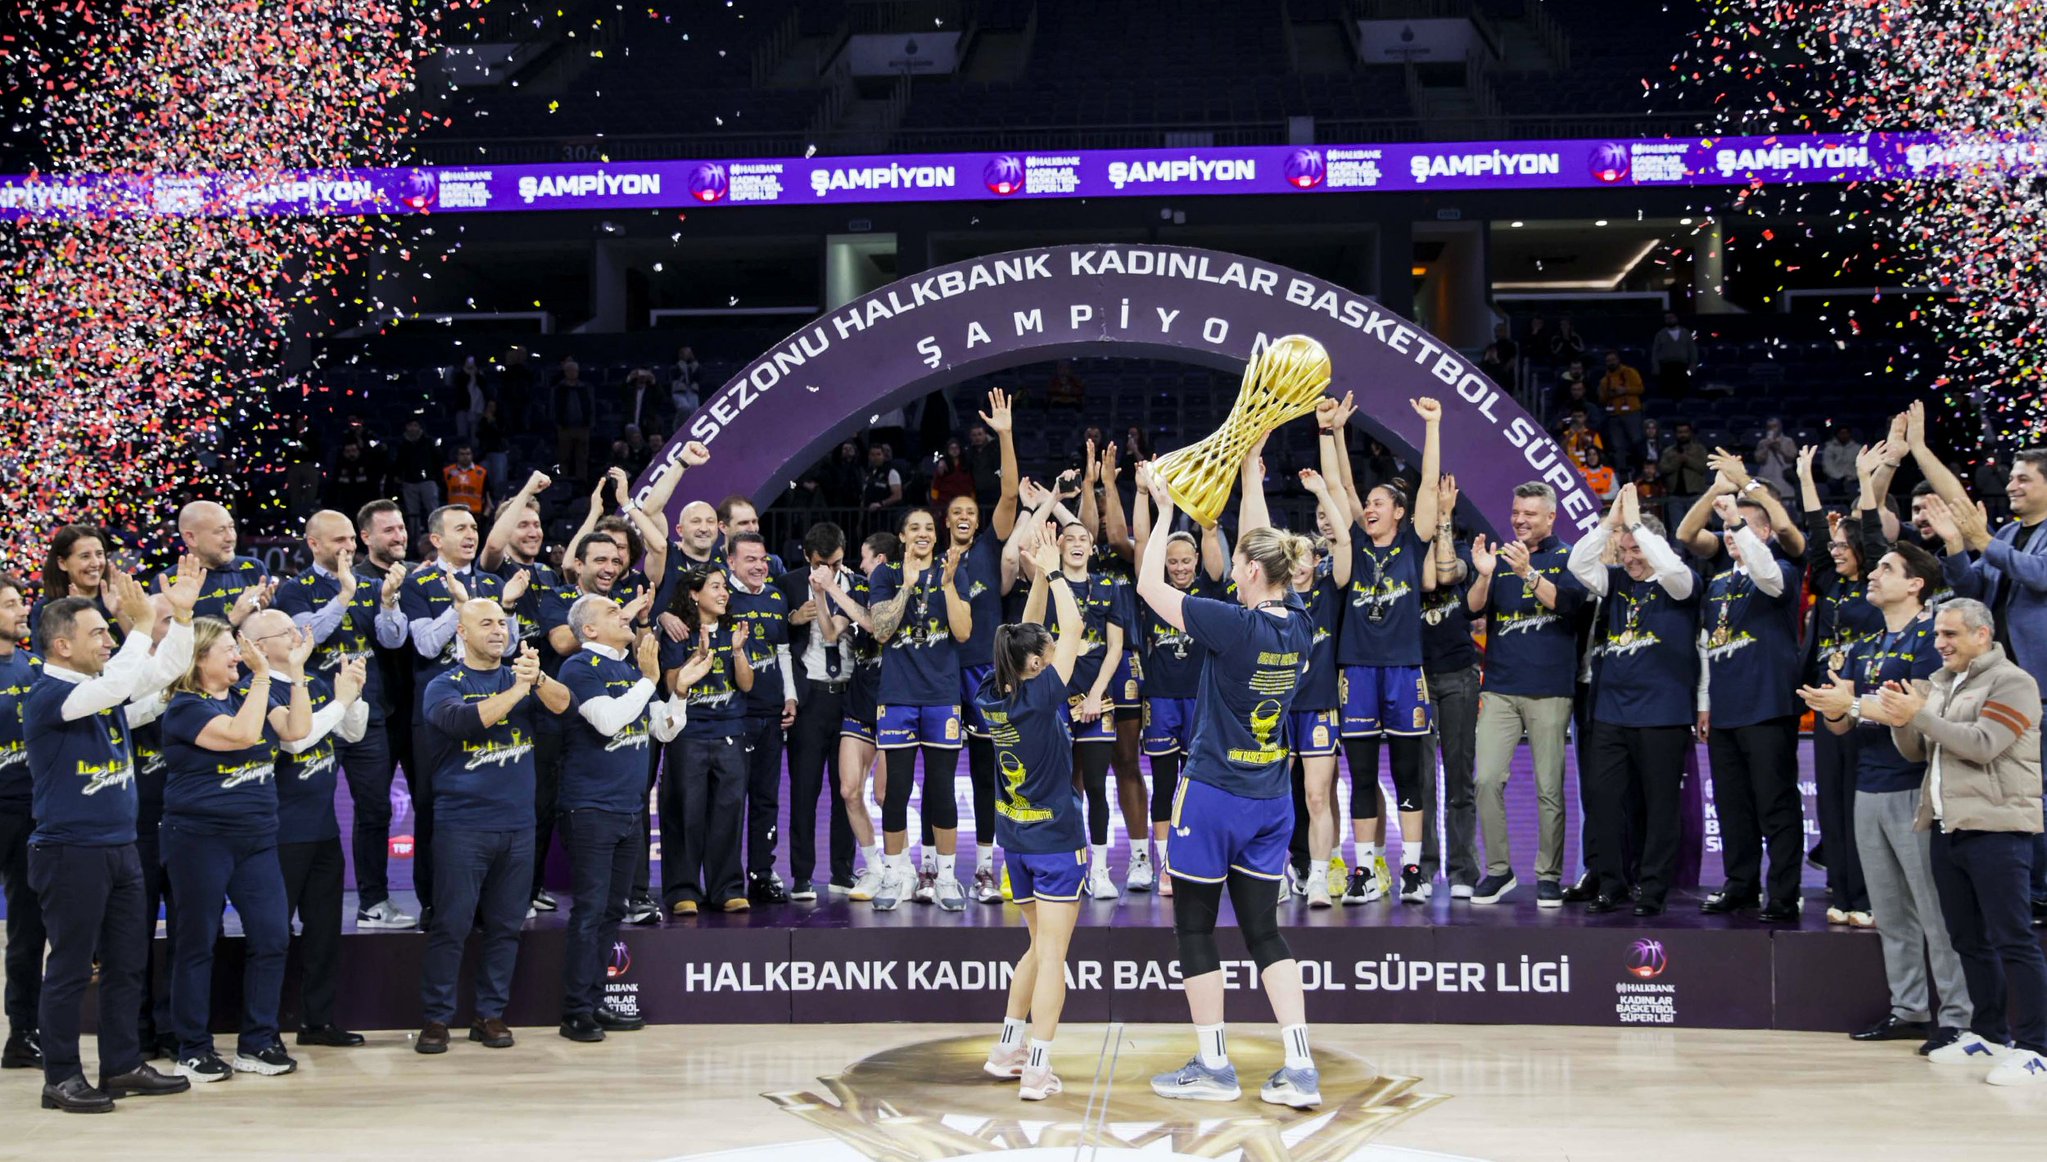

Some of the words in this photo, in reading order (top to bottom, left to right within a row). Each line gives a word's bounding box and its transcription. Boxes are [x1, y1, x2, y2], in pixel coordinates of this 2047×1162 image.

[1109, 155, 1256, 189] ŞAMPİYON
[1411, 149, 1559, 183] ŞAMPİYON
[1716, 142, 1869, 177] ŞAMPİYON
[519, 169, 661, 204] ŞAMPİYON
[811, 162, 955, 197] ŞAMPİYON
[691, 327, 830, 445] SEZONU
[832, 253, 1052, 340] HALKBANK
[1071, 250, 1279, 296] KADINLAR
[1286, 277, 1498, 424] BASKETBOL
[605, 984, 639, 992] LKBANK
[686, 961, 898, 992] HALKBANK
[1114, 960, 1346, 990] BASETOL
[1355, 954, 1486, 992] SÜPER
[1497, 955, 1570, 992] LİGİ
[1627, 984, 1675, 993] HALKBANK
[604, 995, 636, 1004] INLAR
[1616, 1004, 1677, 1014] BASKETBOL
[1620, 996, 1673, 1005] KADINLAR
